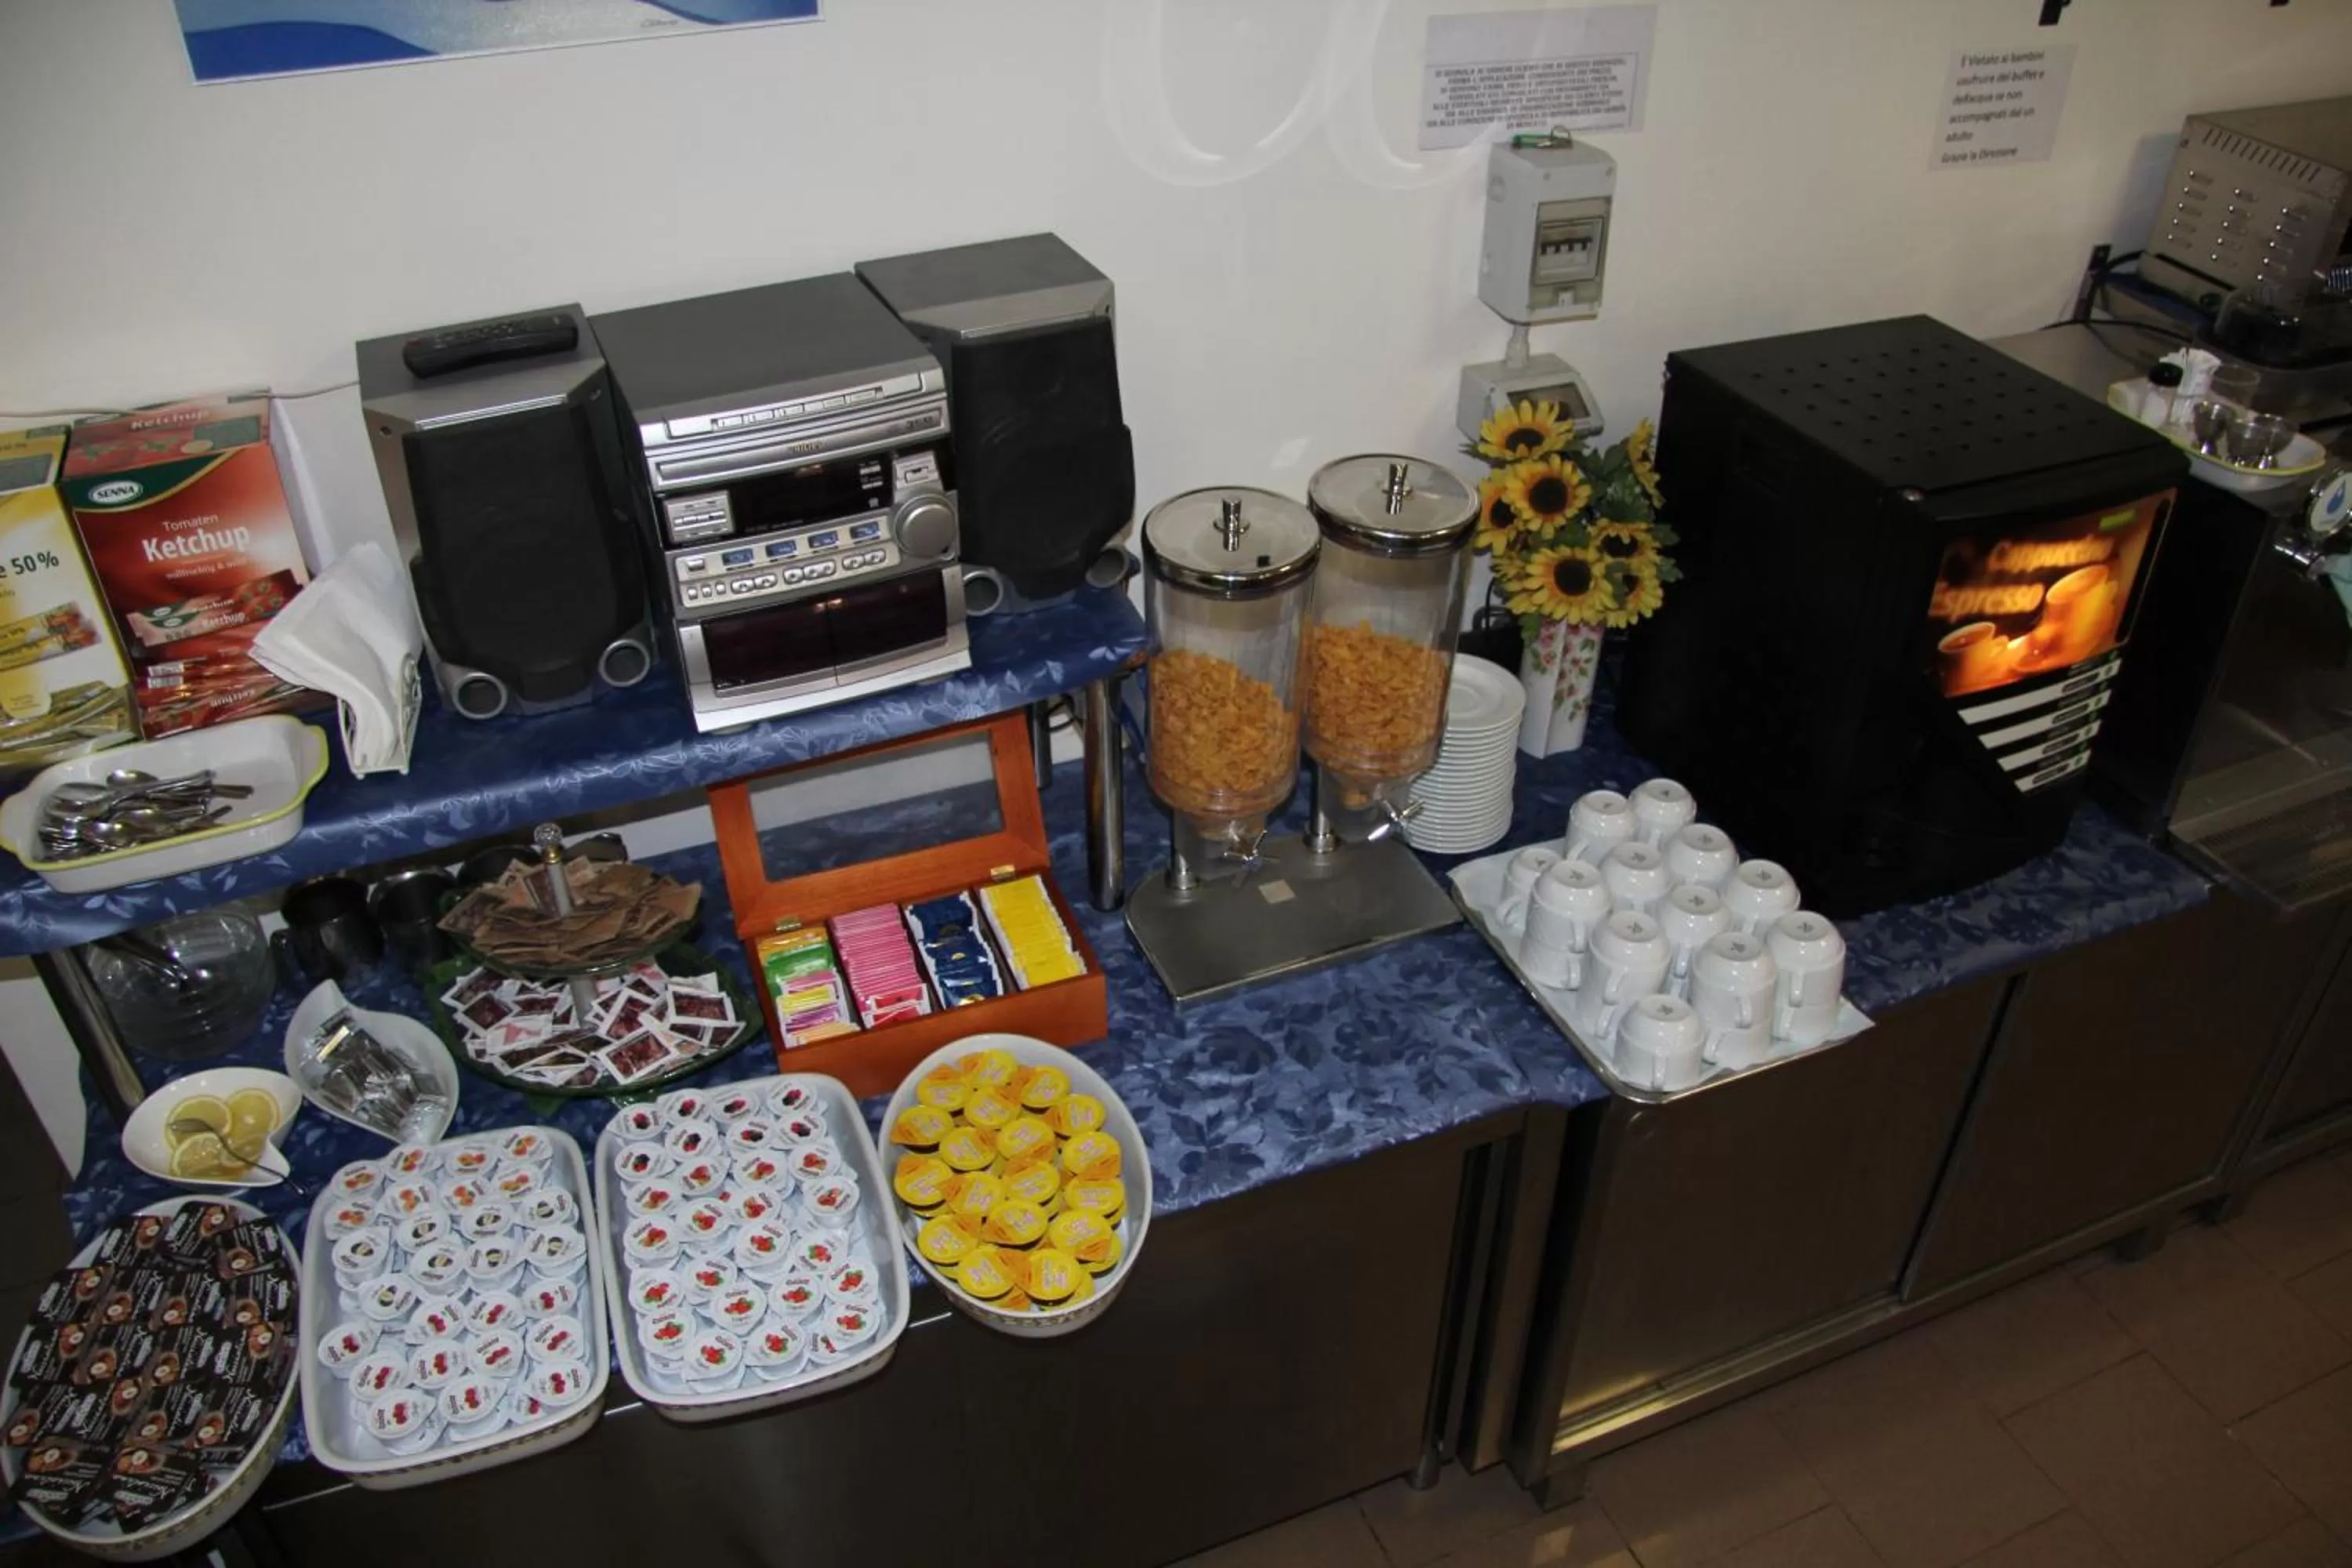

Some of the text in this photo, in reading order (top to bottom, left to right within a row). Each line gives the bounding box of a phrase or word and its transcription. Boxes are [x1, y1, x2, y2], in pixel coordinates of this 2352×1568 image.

[97, 485, 135, 499] SENNA
[162, 514, 219, 532] Tomaten
[142, 524, 251, 562] Ketchup
[1927, 581, 2045, 623] Espresso
